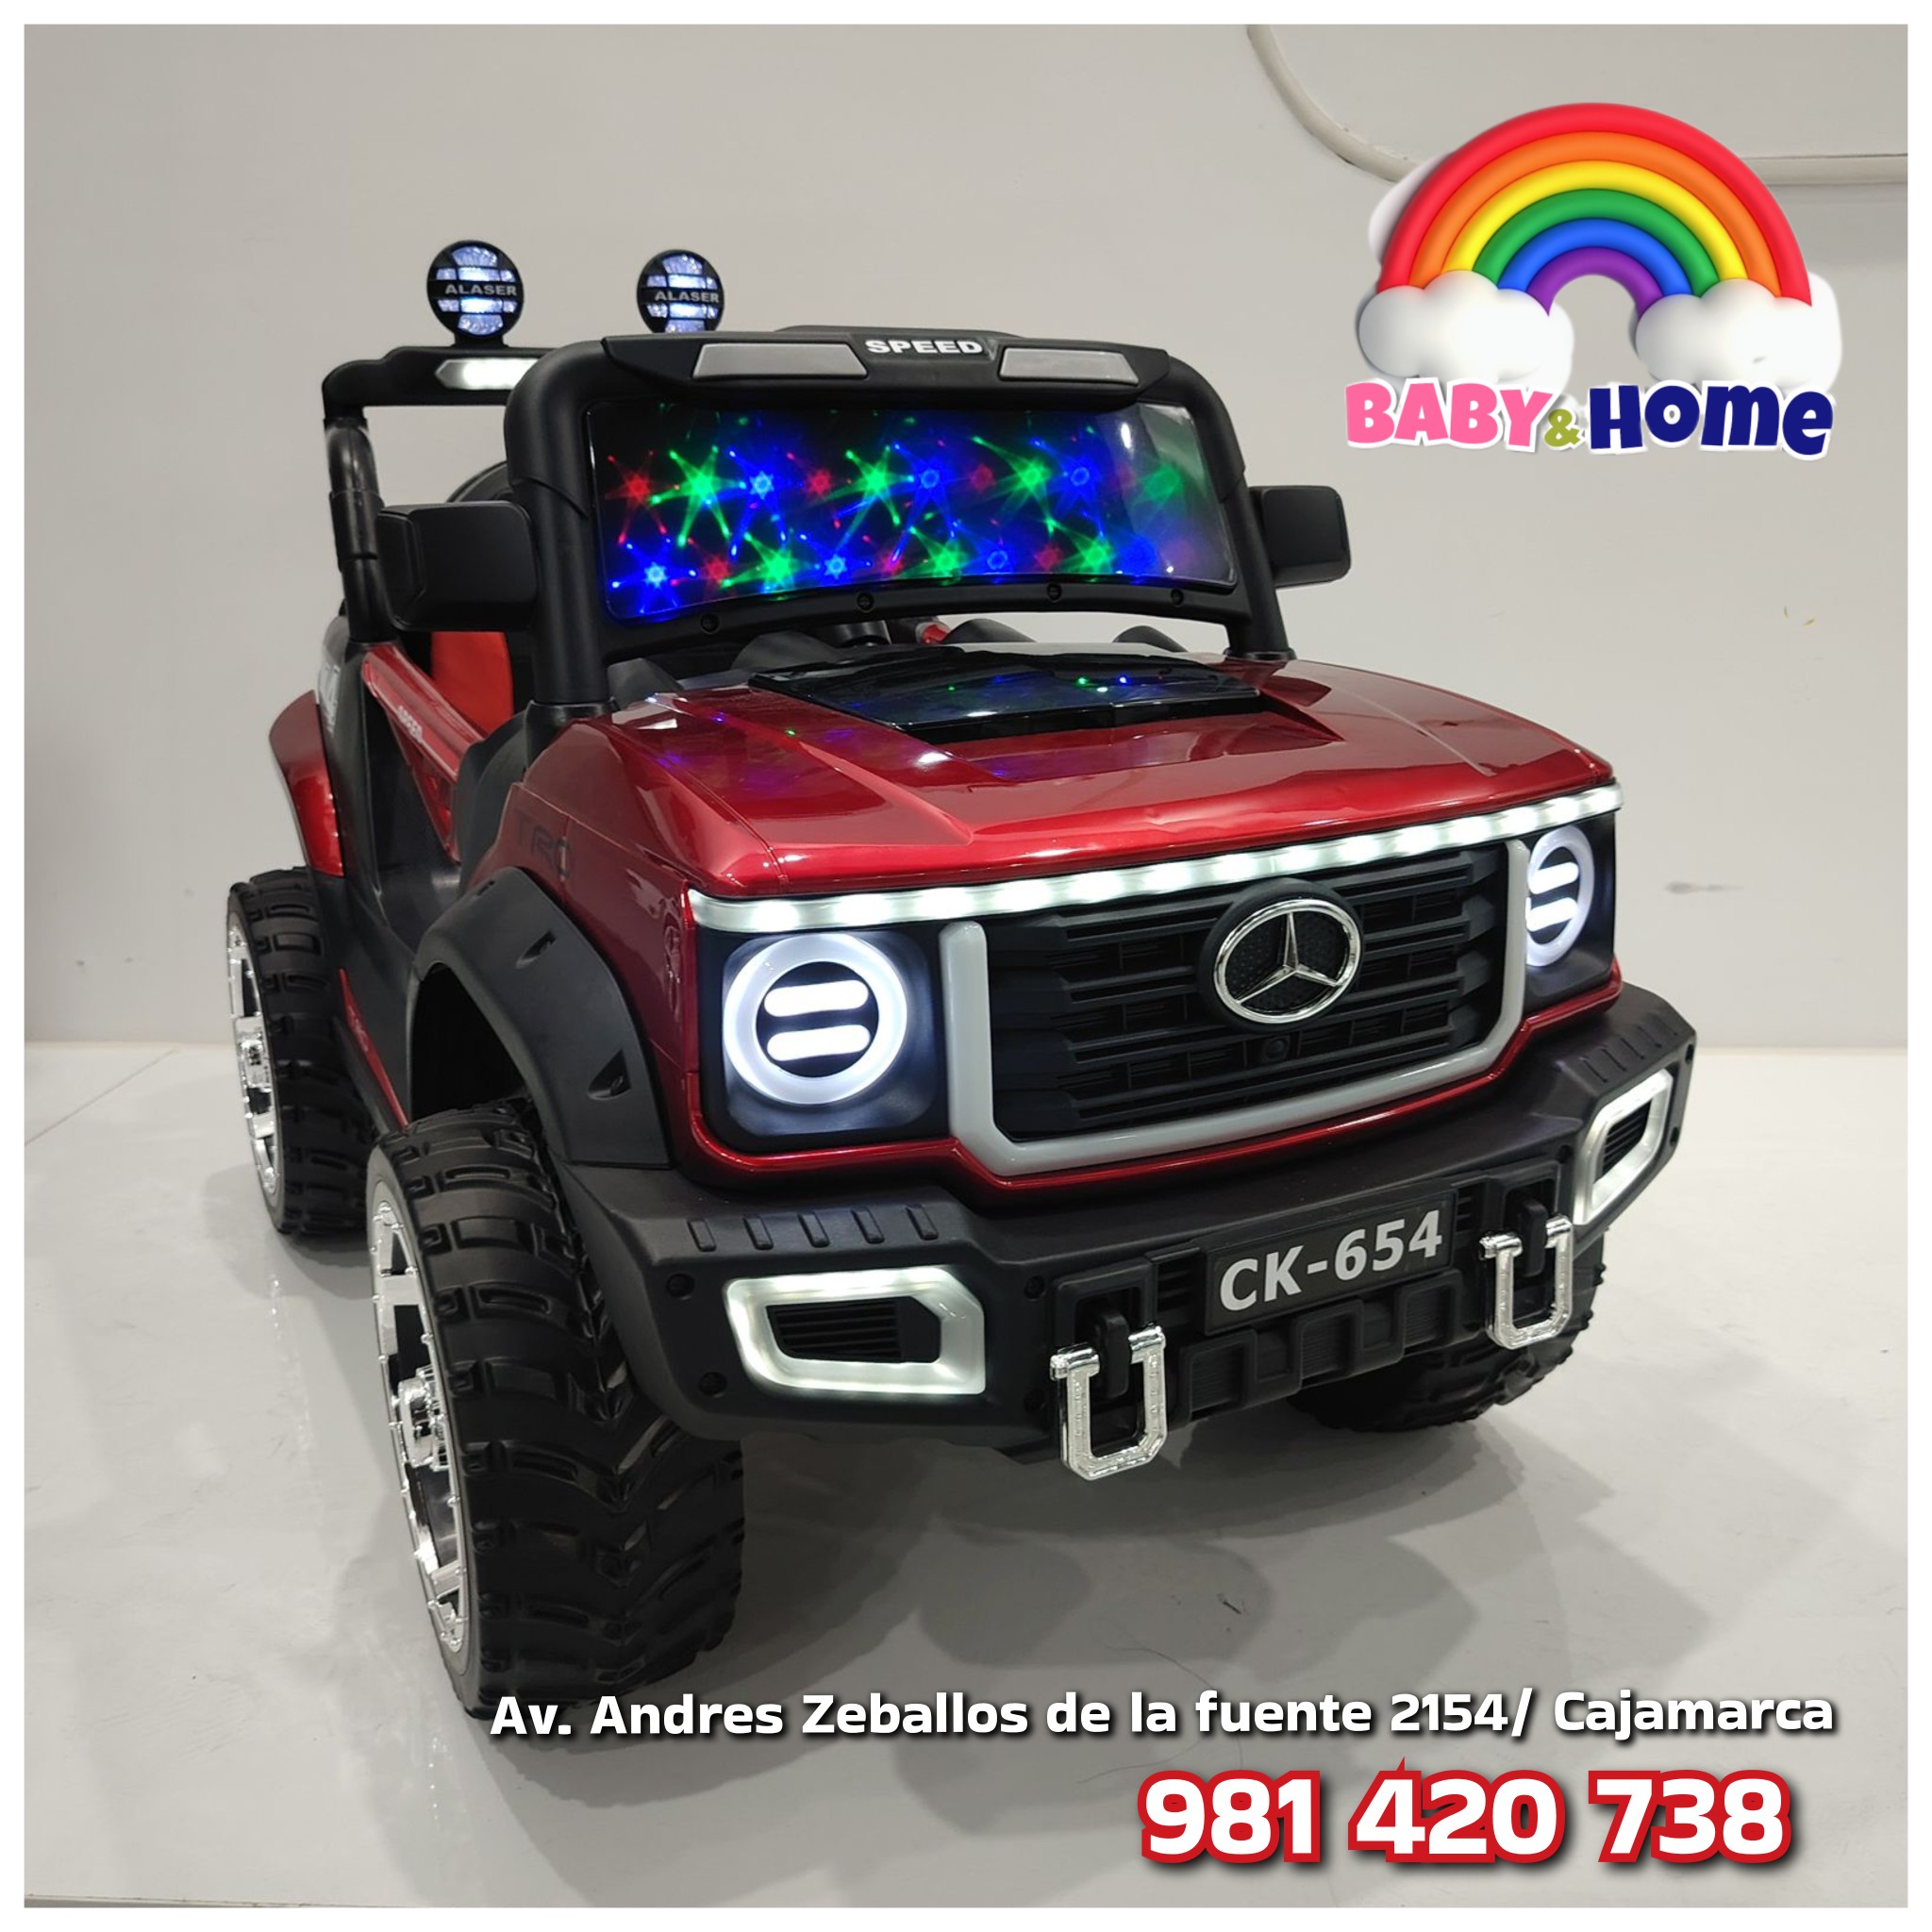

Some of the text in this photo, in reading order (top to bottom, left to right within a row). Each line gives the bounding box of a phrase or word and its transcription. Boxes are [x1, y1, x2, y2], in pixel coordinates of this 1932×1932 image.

[444, 283, 517, 296] ALASER
[654, 290, 719, 304] ALASER
[865, 340, 983, 355] SPEED
[1220, 1209, 1442, 1311] CK-654
